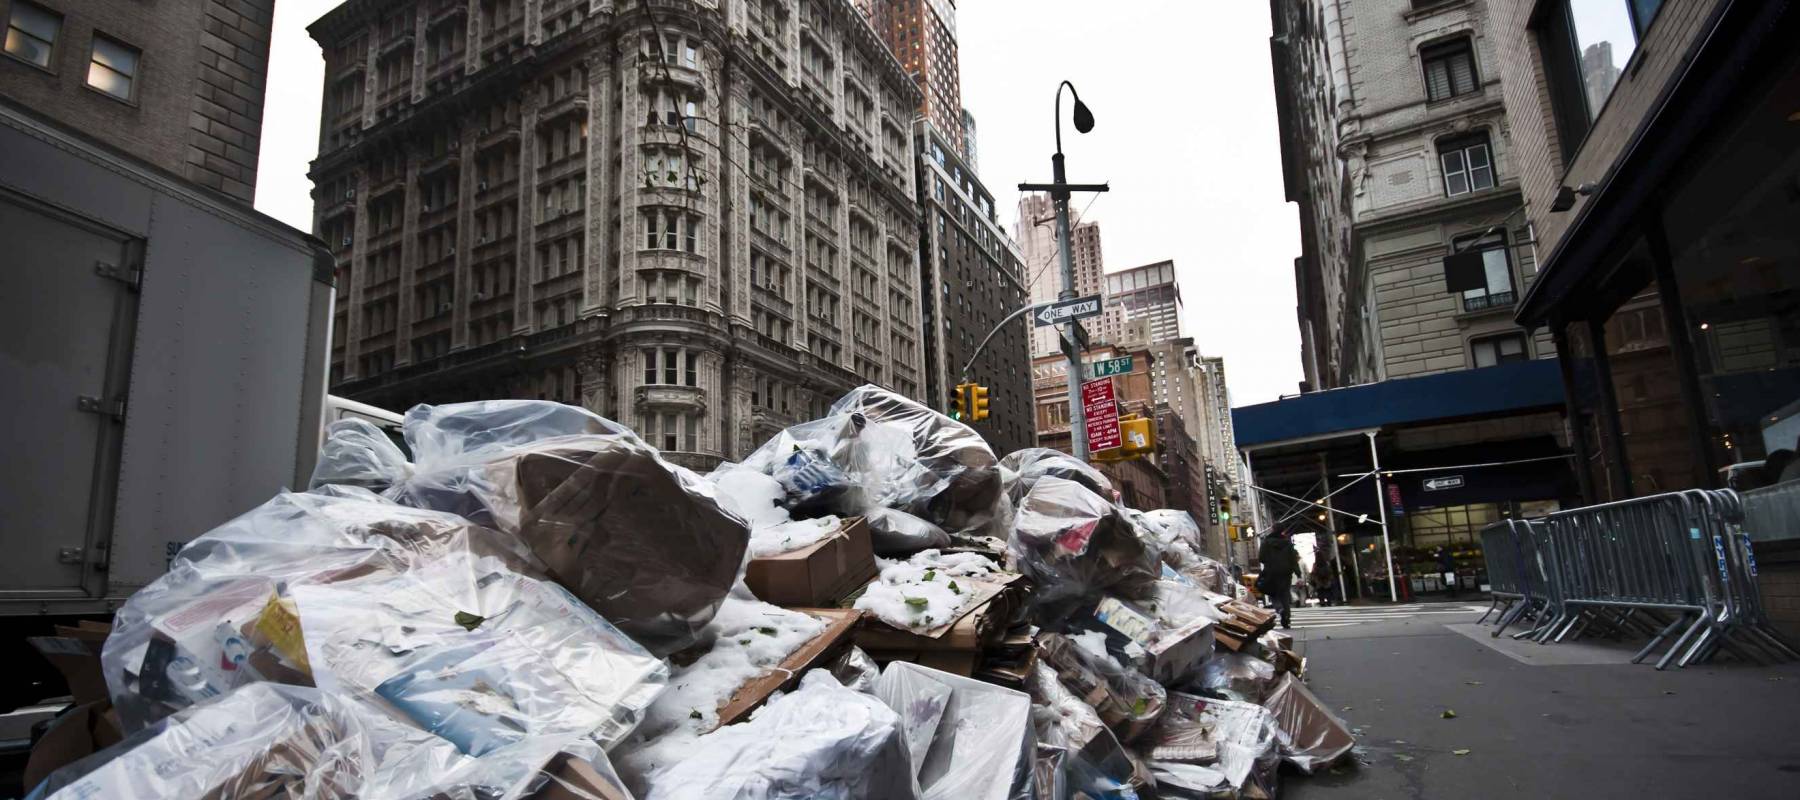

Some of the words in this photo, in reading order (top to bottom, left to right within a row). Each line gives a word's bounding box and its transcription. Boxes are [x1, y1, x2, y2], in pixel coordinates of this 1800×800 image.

[1044, 309, 1062, 320] ONE
[1072, 302, 1093, 314] WAY
[1096, 361, 1105, 376] W
[1108, 359, 1121, 375] 58
[1086, 405, 1093, 413] NO
[1206, 465, 1218, 524] WELLINGTON
